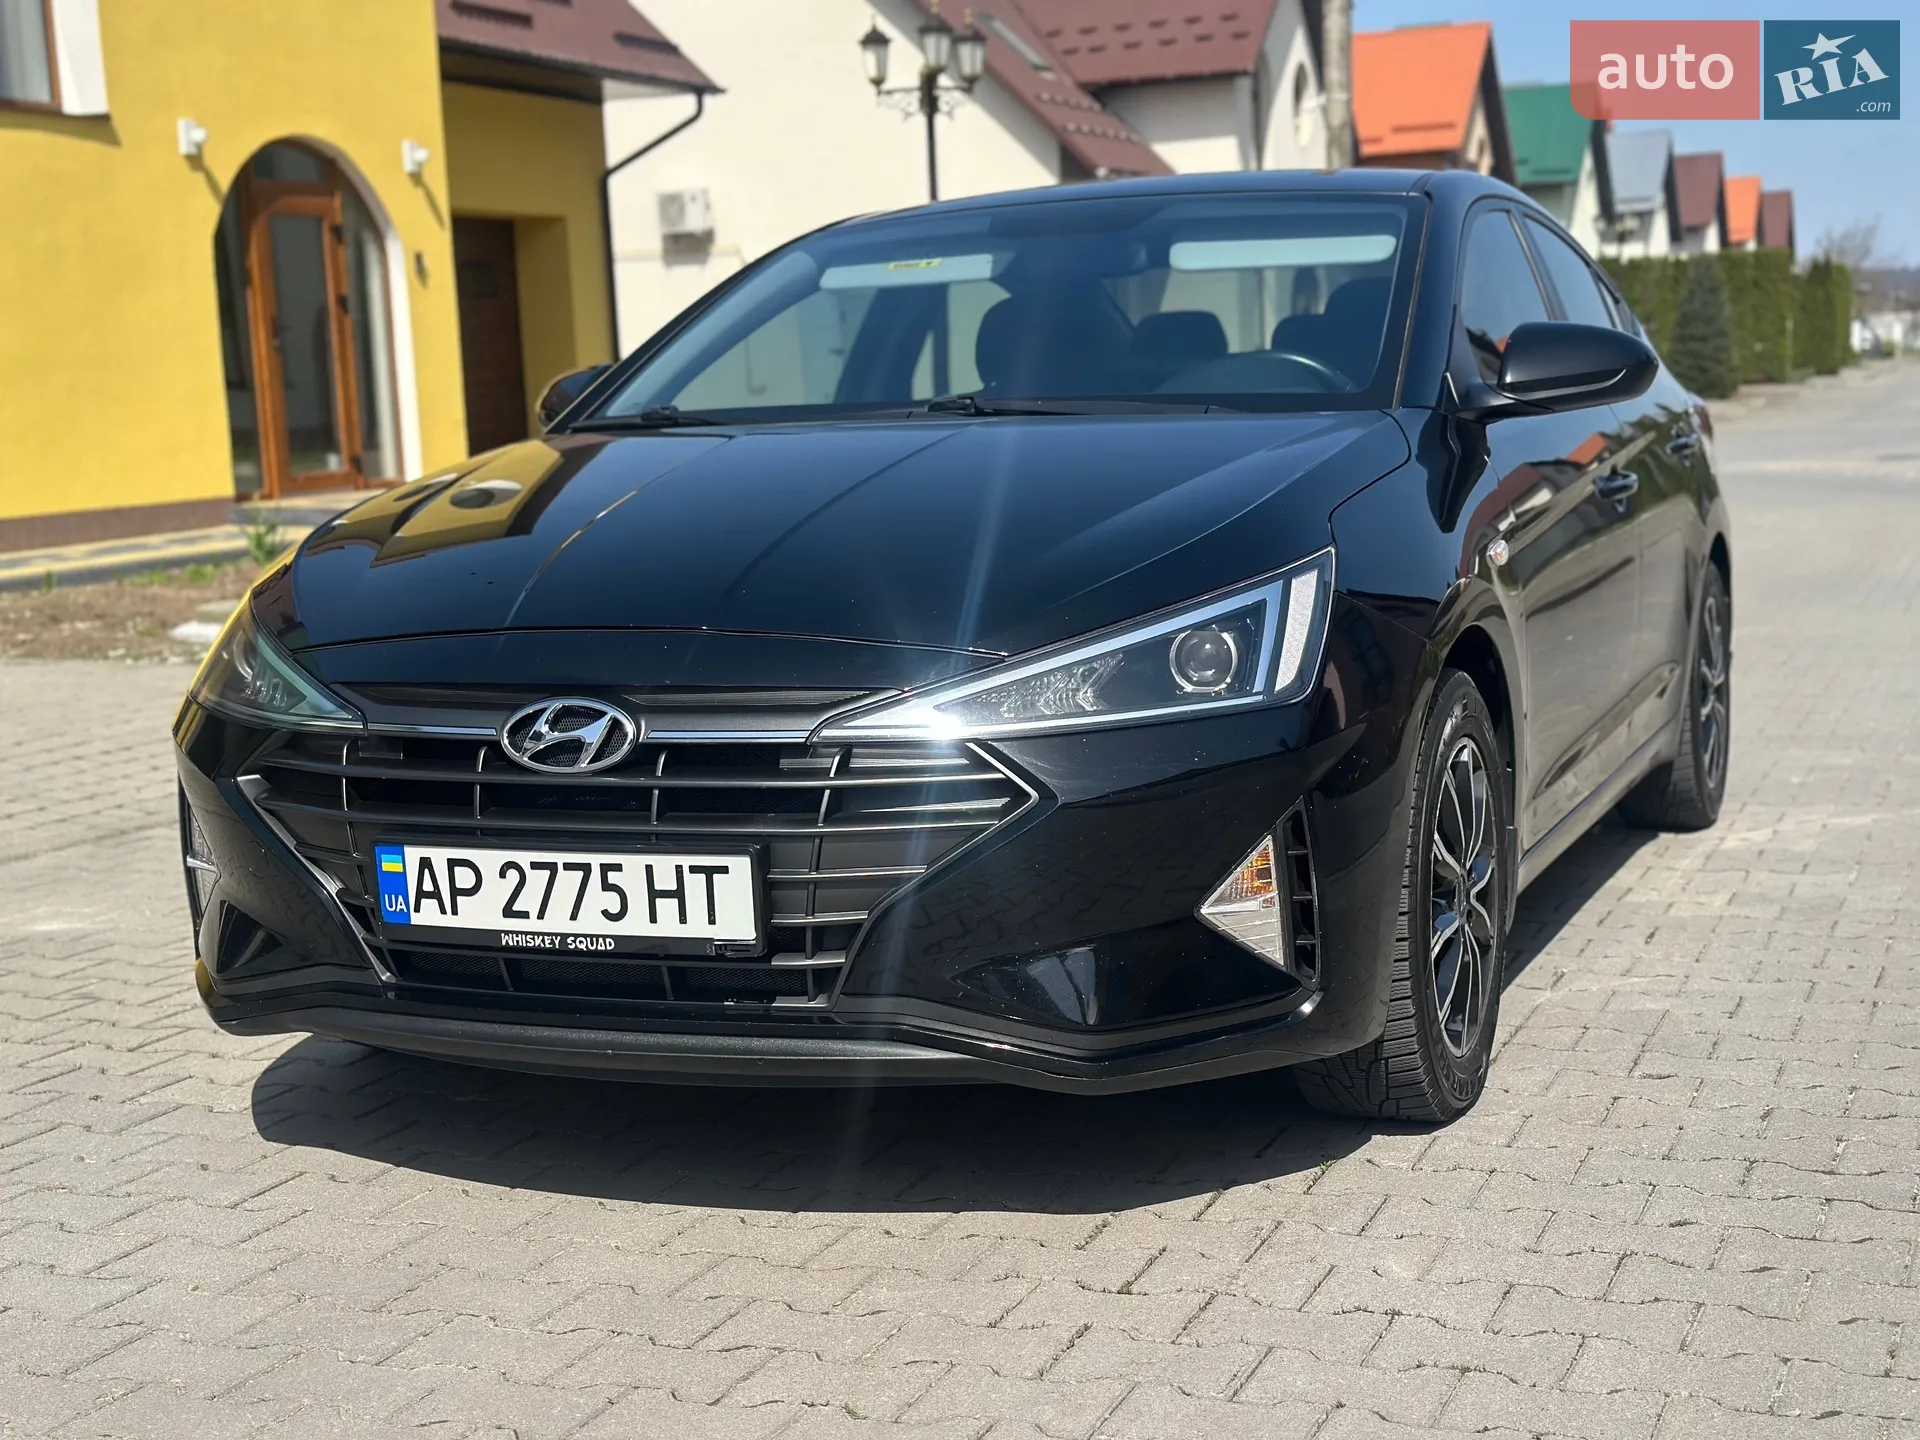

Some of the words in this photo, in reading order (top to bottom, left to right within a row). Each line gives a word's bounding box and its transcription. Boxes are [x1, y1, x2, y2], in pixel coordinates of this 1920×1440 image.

[413, 856, 483, 916] AP
[499, 861, 629, 922] 2775
[645, 864, 730, 926] HT
[385, 894, 407, 912] UA
[500, 933, 561, 949] WHISKEY
[567, 938, 616, 951] SQUAD
